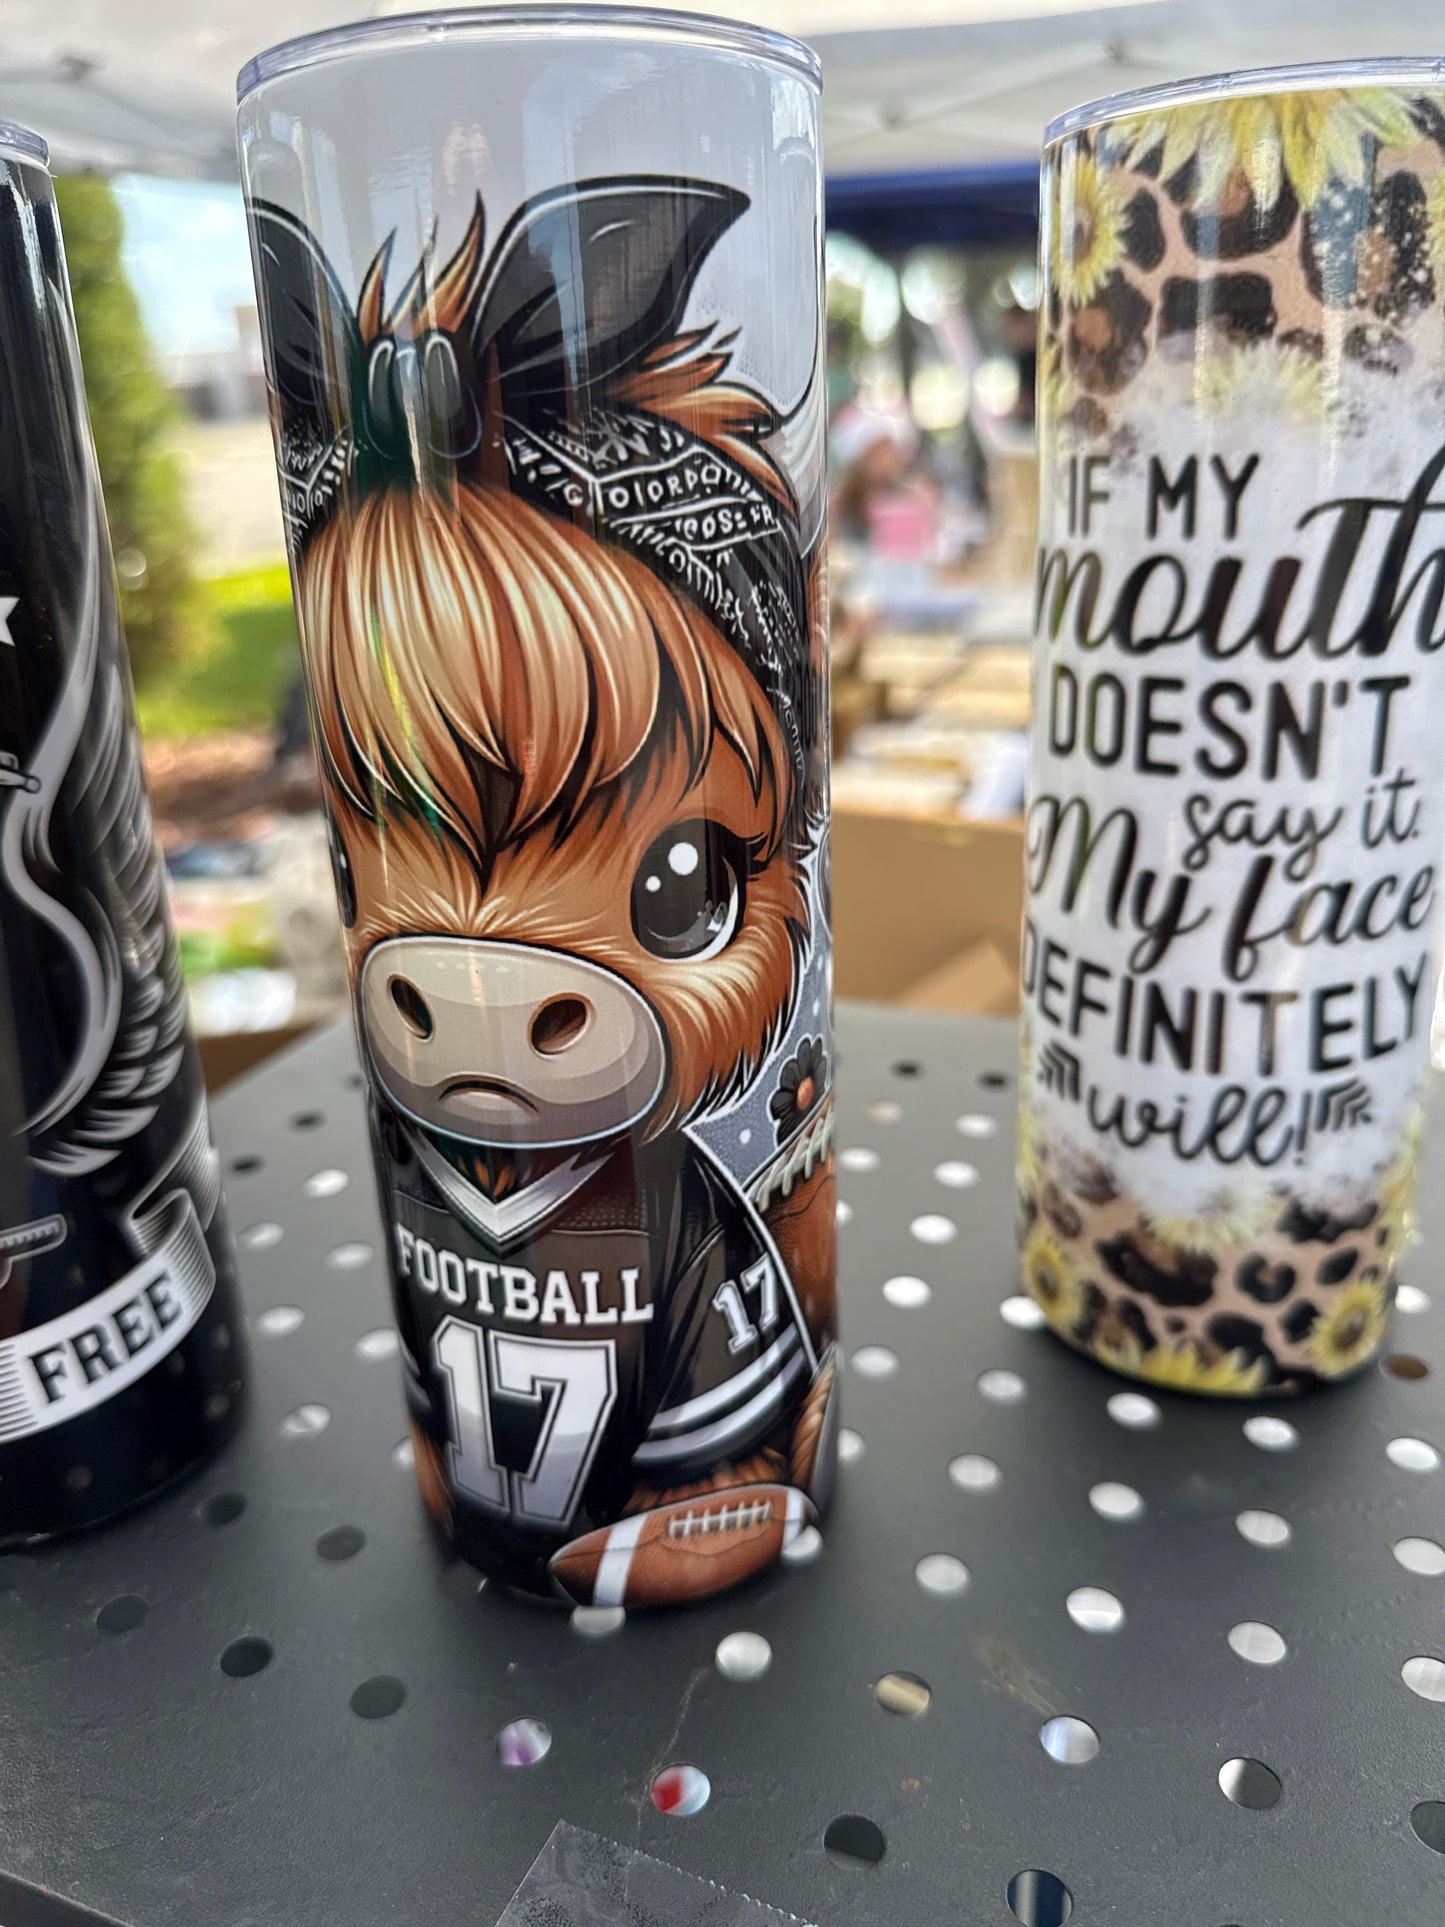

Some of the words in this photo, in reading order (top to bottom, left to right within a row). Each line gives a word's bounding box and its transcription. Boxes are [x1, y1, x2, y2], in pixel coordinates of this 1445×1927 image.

[1068, 454, 1111, 537] IF
[1146, 452, 1261, 541] MY
[1049, 663, 1411, 782] DOESN'T
[1028, 796, 1212, 974] My
[1223, 855, 1435, 982] face
[1183, 795, 1344, 882] say
[1022, 915, 1427, 1077] DEFINITELY
[1088, 1084, 1313, 1167] will!
[397, 1222, 655, 1325] FOOTBALL
[712, 1252, 780, 1355] 17
[27, 1272, 184, 1403] FREE
[431, 1314, 619, 1526] 17
